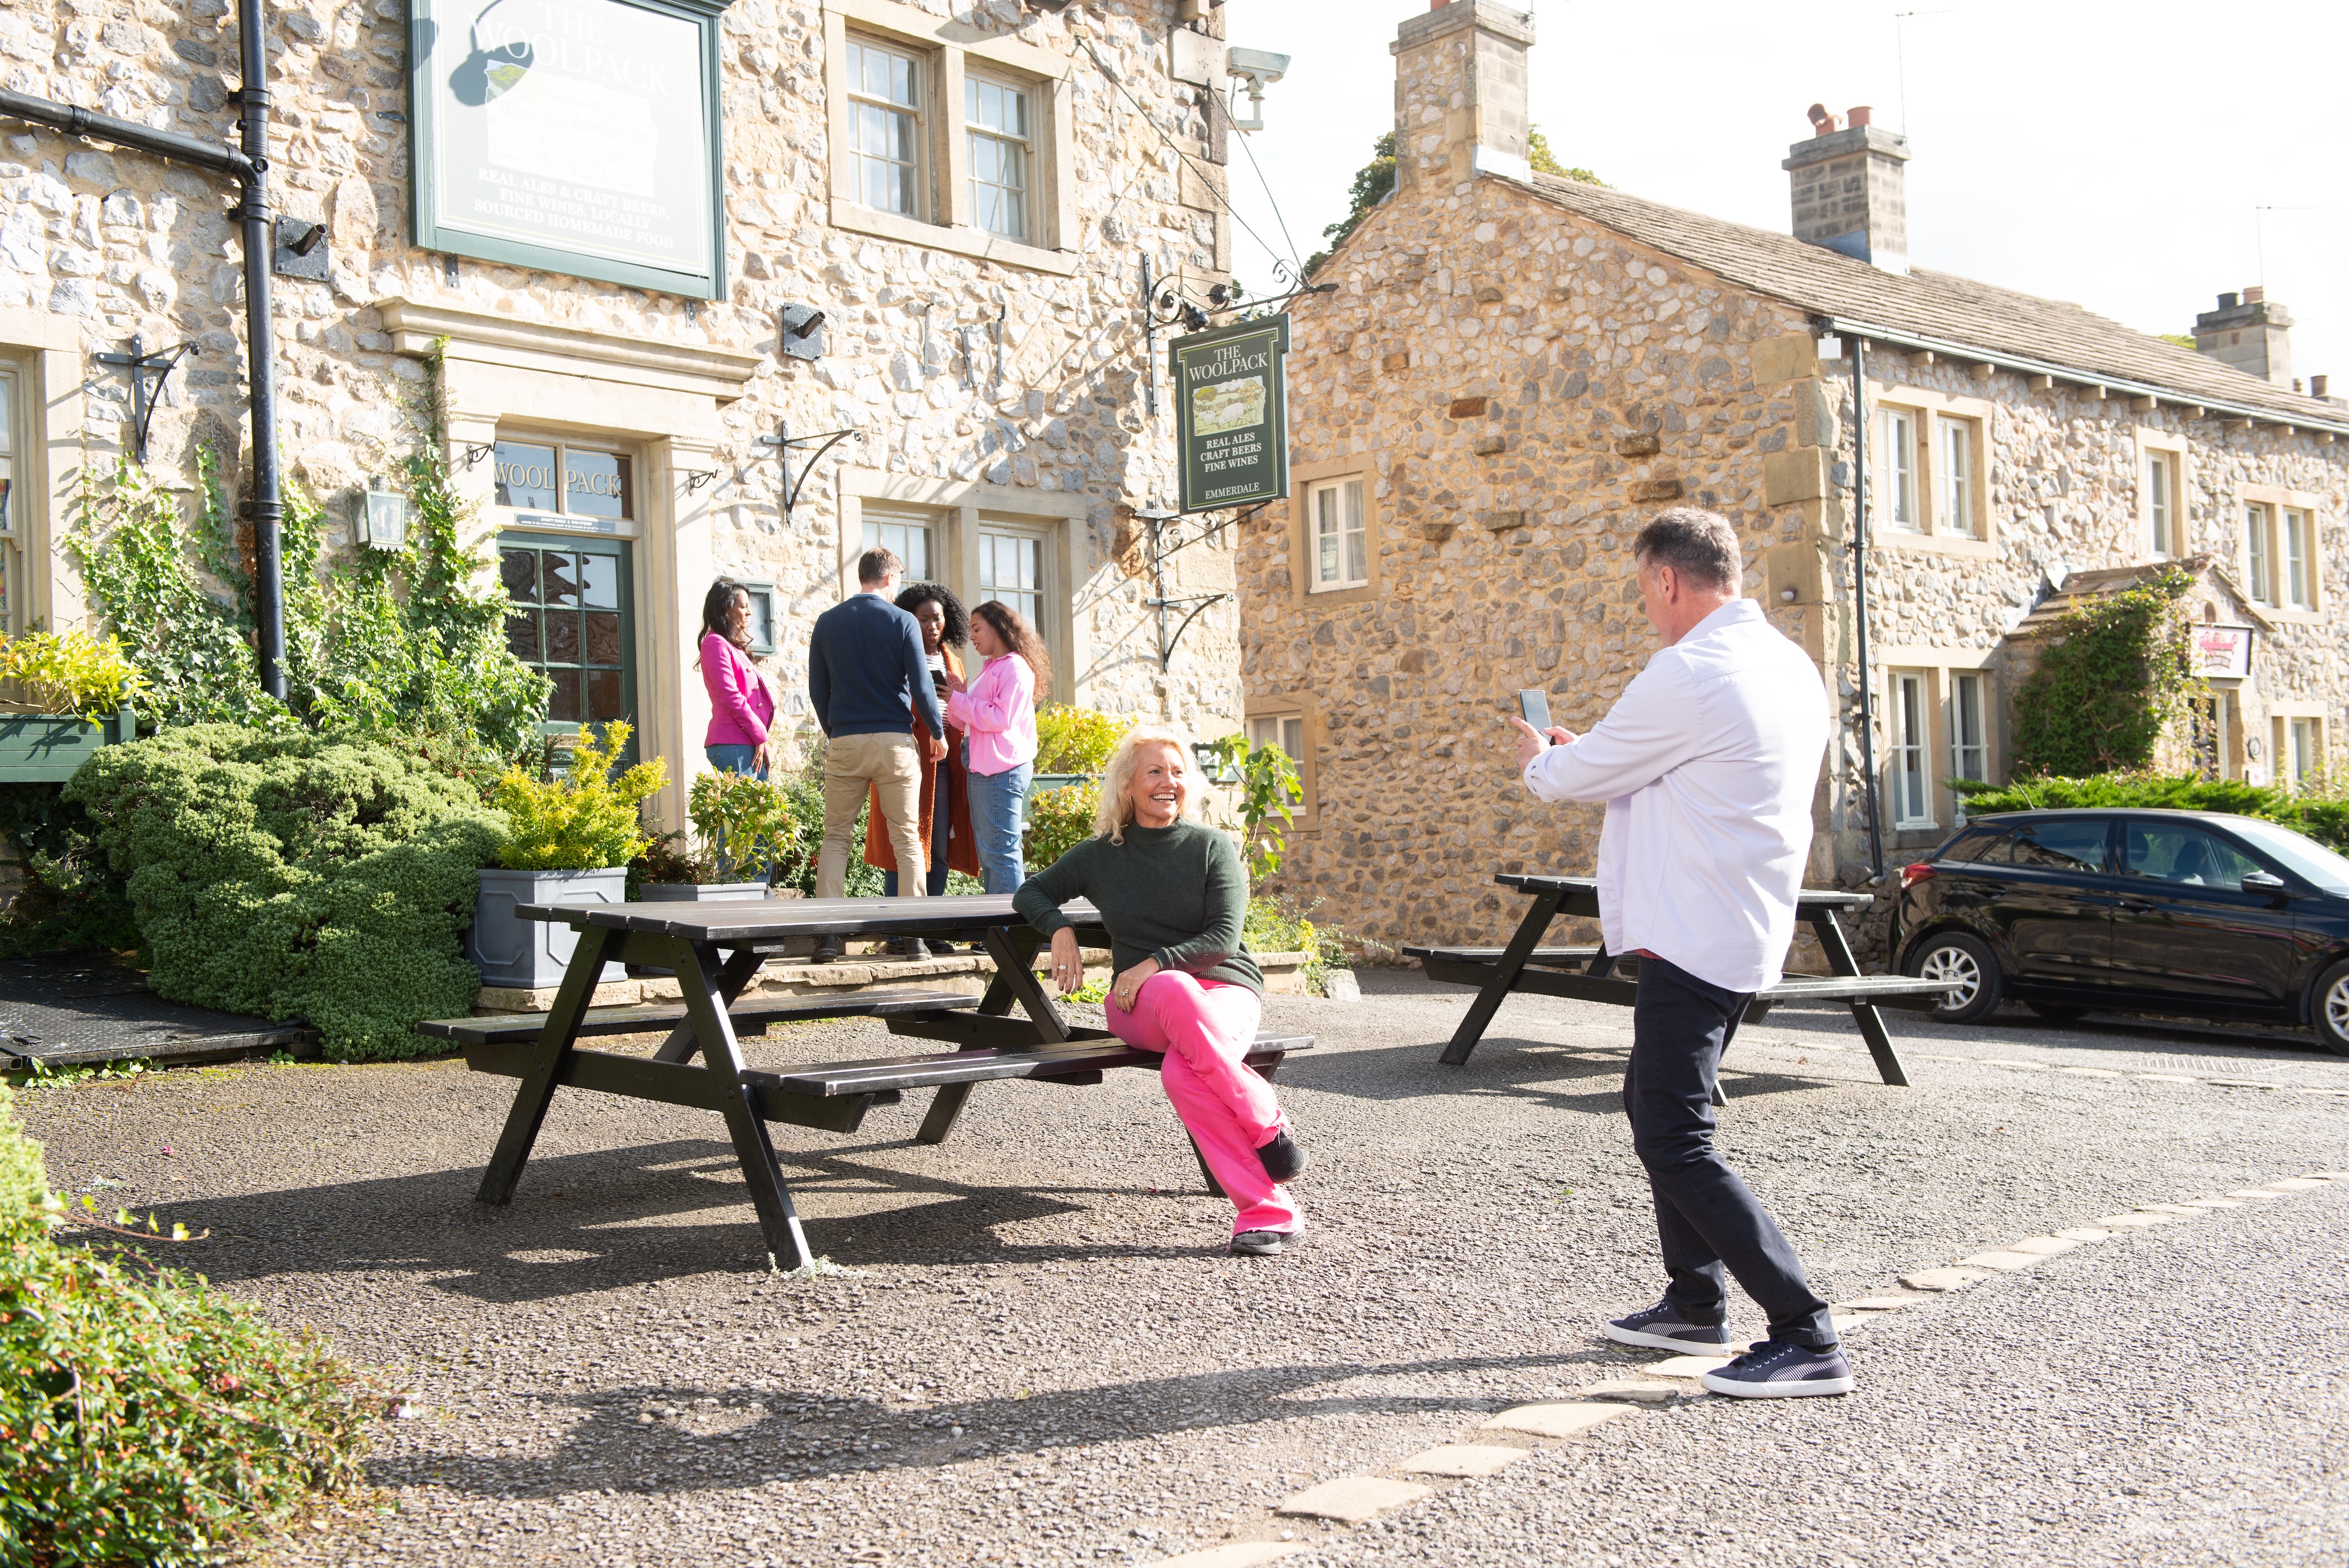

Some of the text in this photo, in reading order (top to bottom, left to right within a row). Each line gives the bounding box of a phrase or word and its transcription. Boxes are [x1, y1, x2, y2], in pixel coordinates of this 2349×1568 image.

[537, 1, 605, 45] THE
[468, 14, 670, 96] WOOLPACK
[478, 167, 669, 220] REAL ALES & CRAFT BEERS,
[500, 187, 651, 229] FINE WINES, LOCALLY
[474, 199, 674, 248] SOURCED HOMEMADE FOOD
[1189, 352, 1268, 381] WOOLPACK
[1214, 345, 1241, 362] THE
[1200, 443, 1262, 462] CRAFT BEERS
[1206, 432, 1255, 449] REAL ALES
[494, 462, 622, 497] WOOL PACK
[1204, 455, 1258, 472] FINE WINES
[1205, 482, 1260, 499] EMMERDALE
